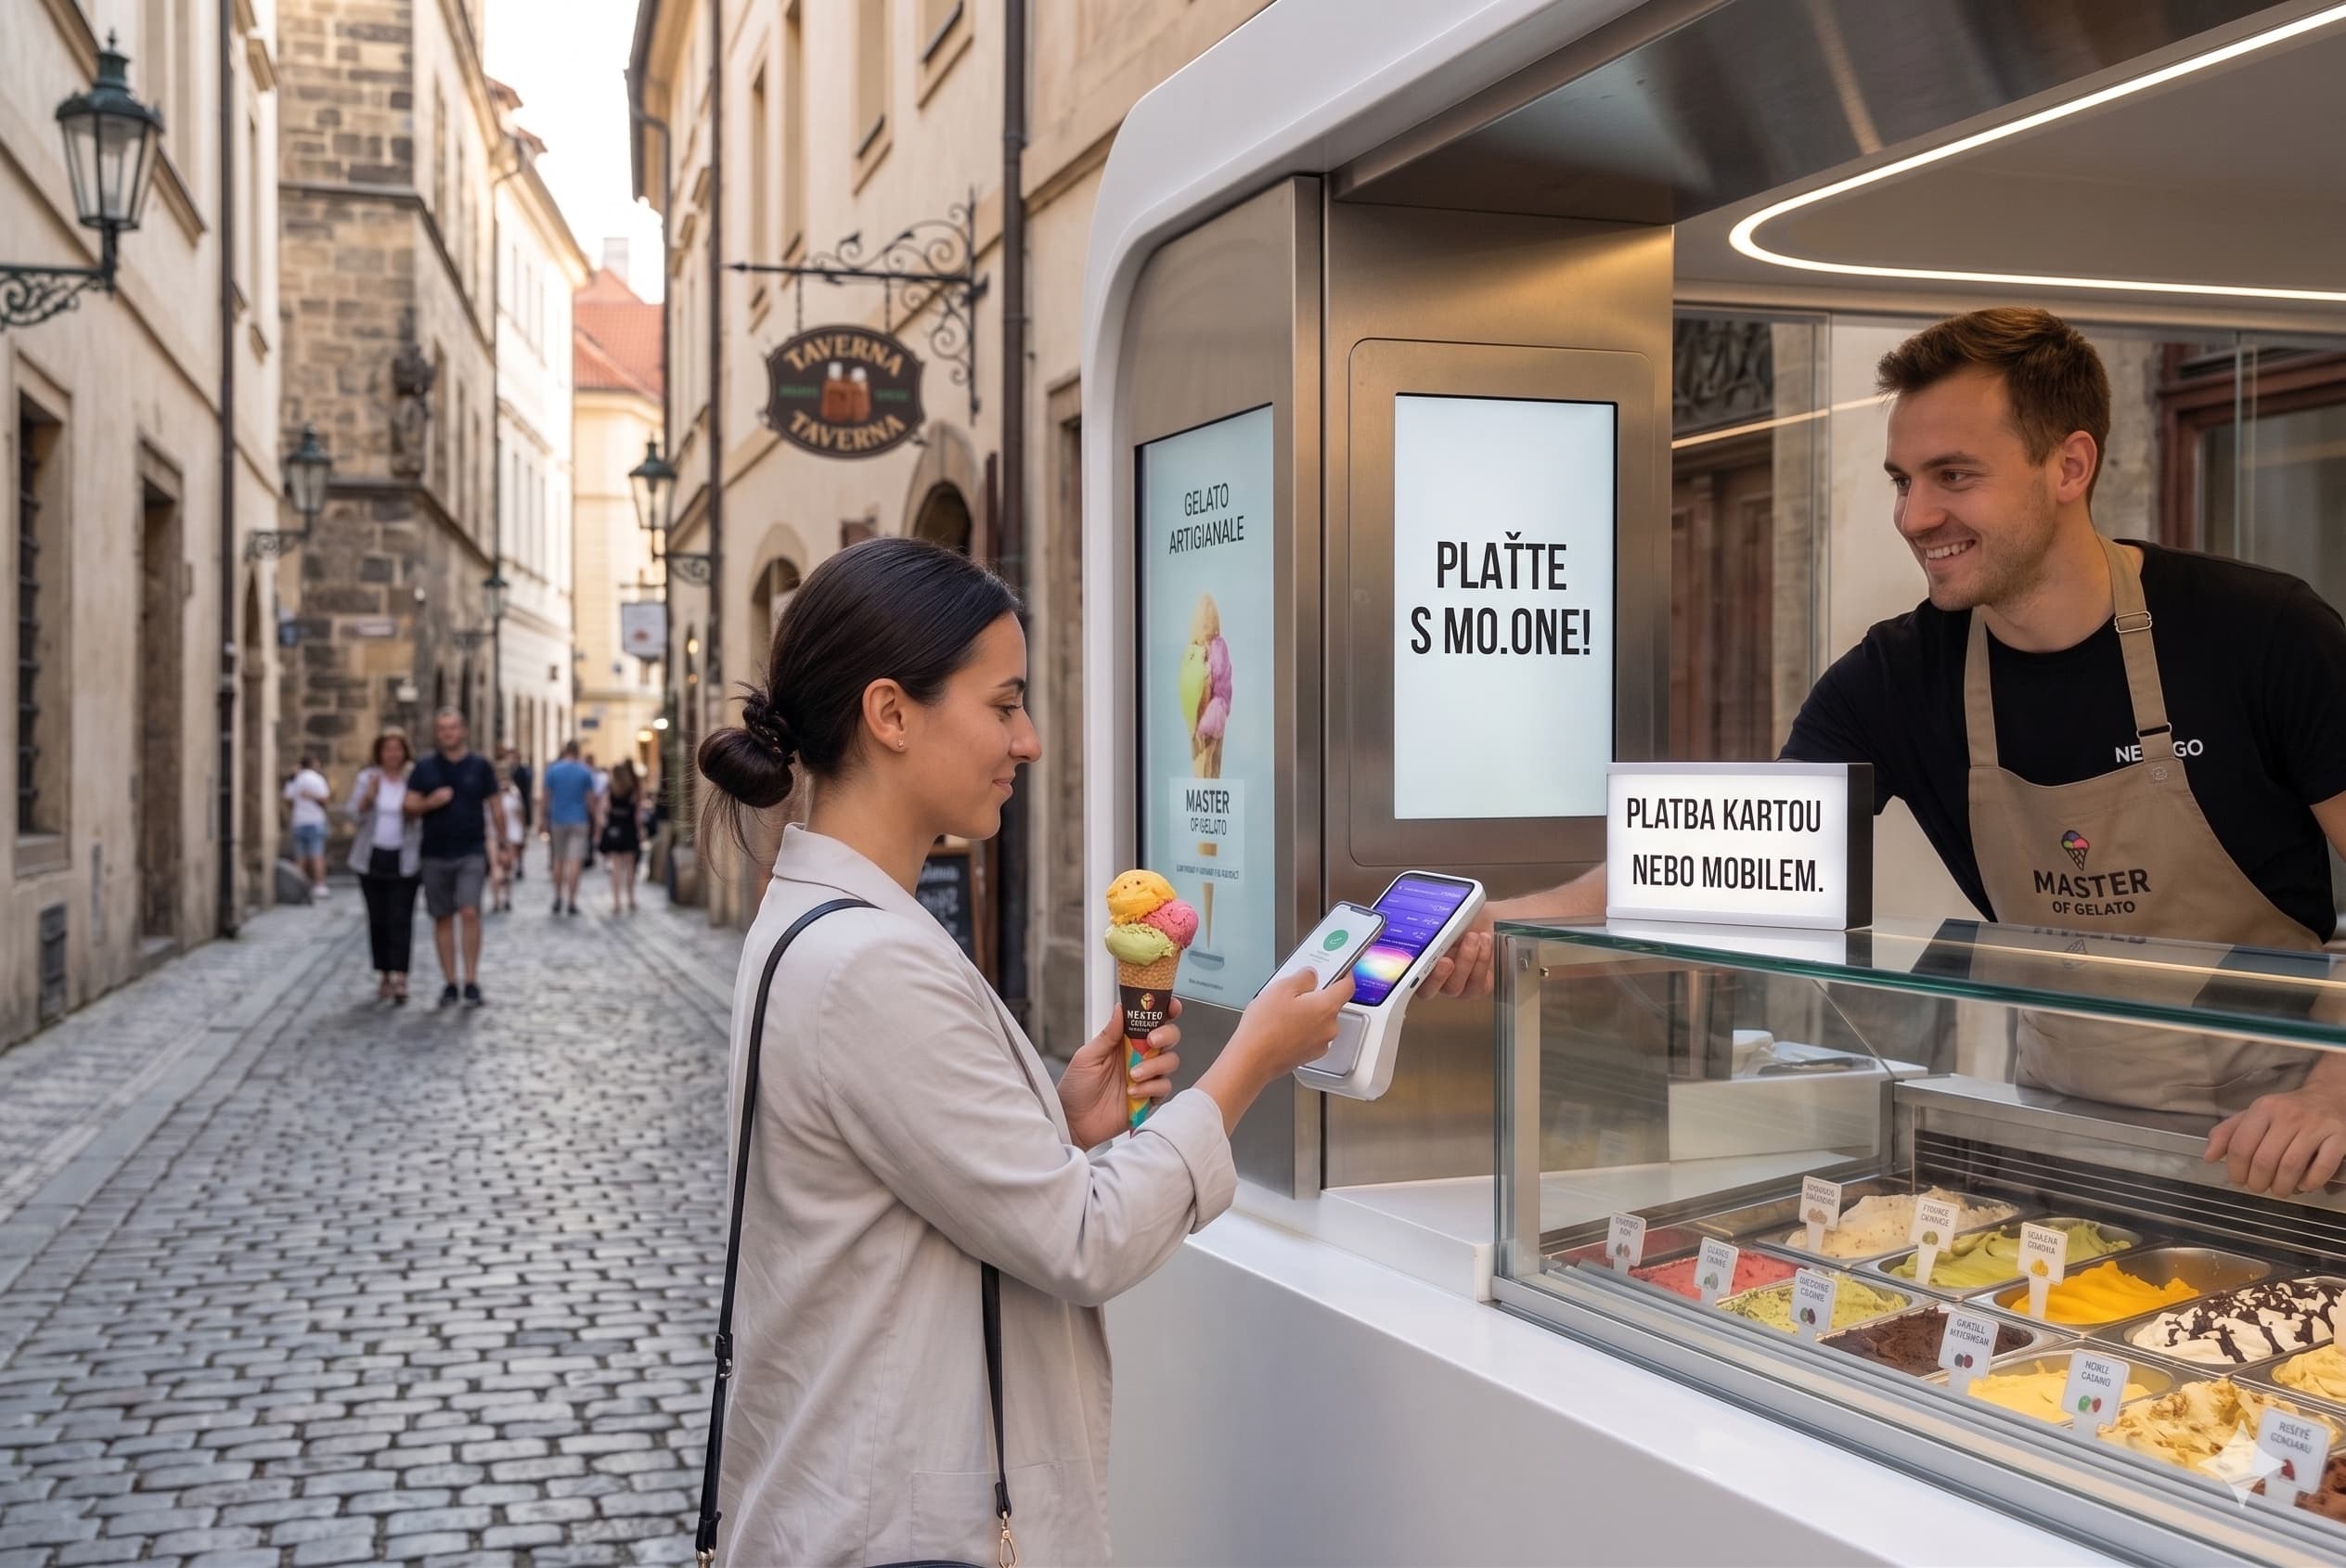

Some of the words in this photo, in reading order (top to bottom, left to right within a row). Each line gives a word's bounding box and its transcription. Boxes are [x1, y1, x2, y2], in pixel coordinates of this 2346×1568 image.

[783, 335, 904, 378] TAVERNA
[790, 409, 907, 451] TAVERNA
[1184, 482, 1229, 517] GELATO
[1169, 515, 1244, 555] ARTIGIANALE
[1437, 531, 1567, 591] PLAŤTE
[1411, 606, 1432, 655] S
[1444, 607, 1591, 655] MO.ONE!
[2115, 739, 2204, 764] NEGO
[1186, 789, 1230, 815] MASTER
[1627, 797, 1716, 830] PLATBA
[1723, 798, 1821, 833] KARTOU
[1191, 817, 1199, 832] OF
[1632, 854, 1695, 888] NEBO
[1702, 855, 1824, 893] MOBILEM.
[2033, 868, 2151, 899] MASTER
[2052, 901, 2070, 914] OF
[2075, 901, 2136, 916] GELATO
